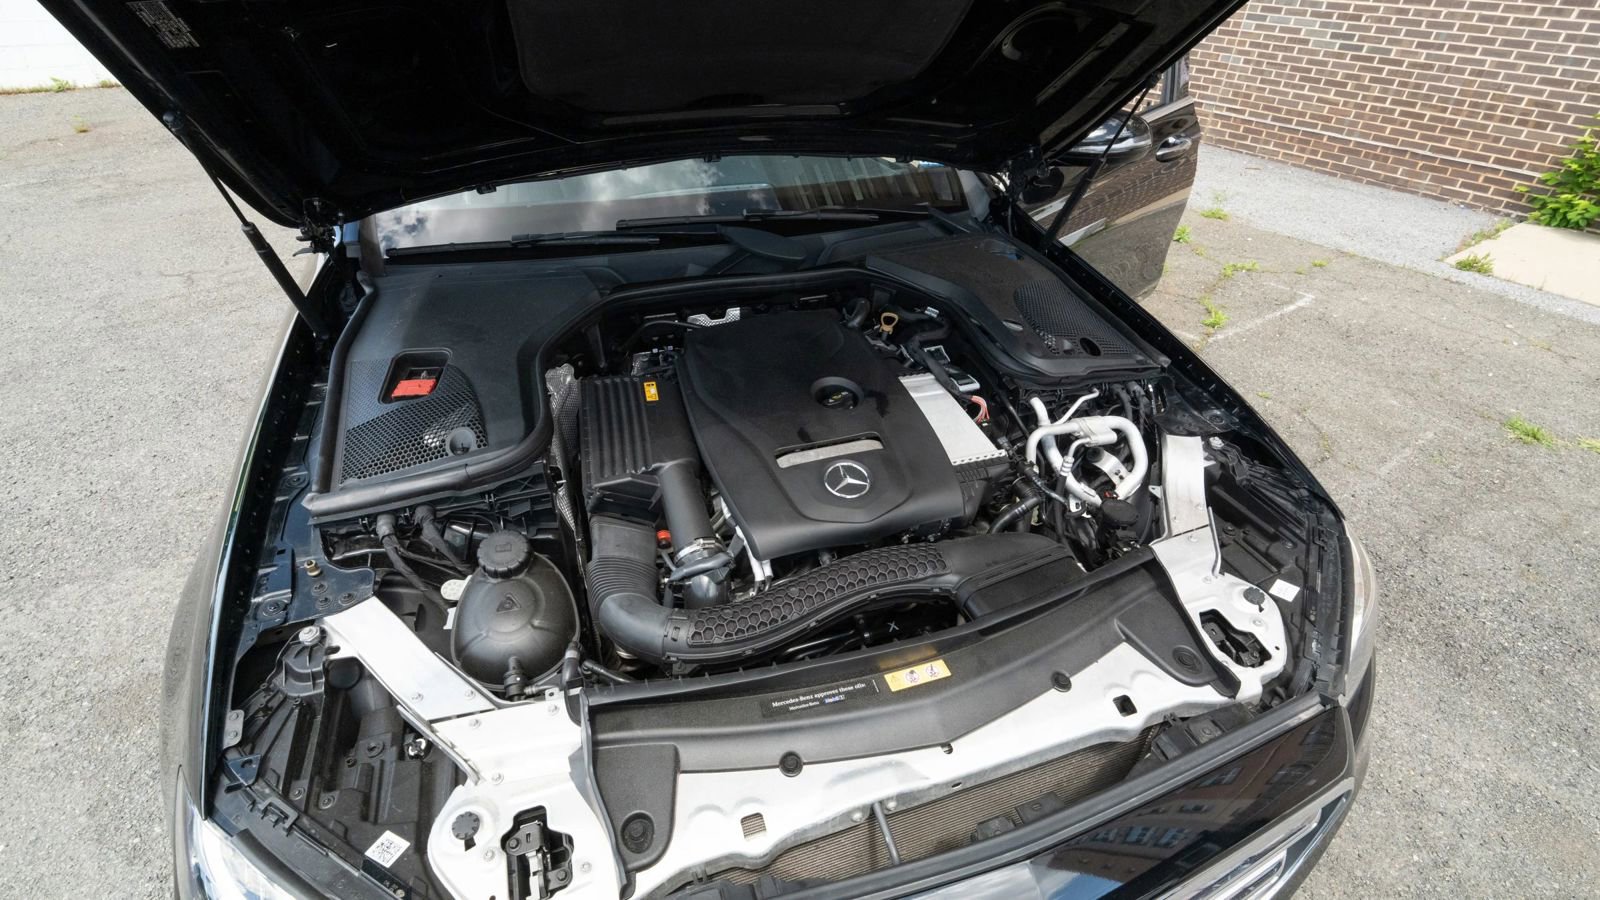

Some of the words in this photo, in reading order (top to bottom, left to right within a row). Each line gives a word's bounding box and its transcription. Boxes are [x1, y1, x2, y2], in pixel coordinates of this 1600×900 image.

[771, 695, 814, 708] Mercedes-Benz
[814, 689, 839, 699] approves
[839, 685, 854, 693] these
